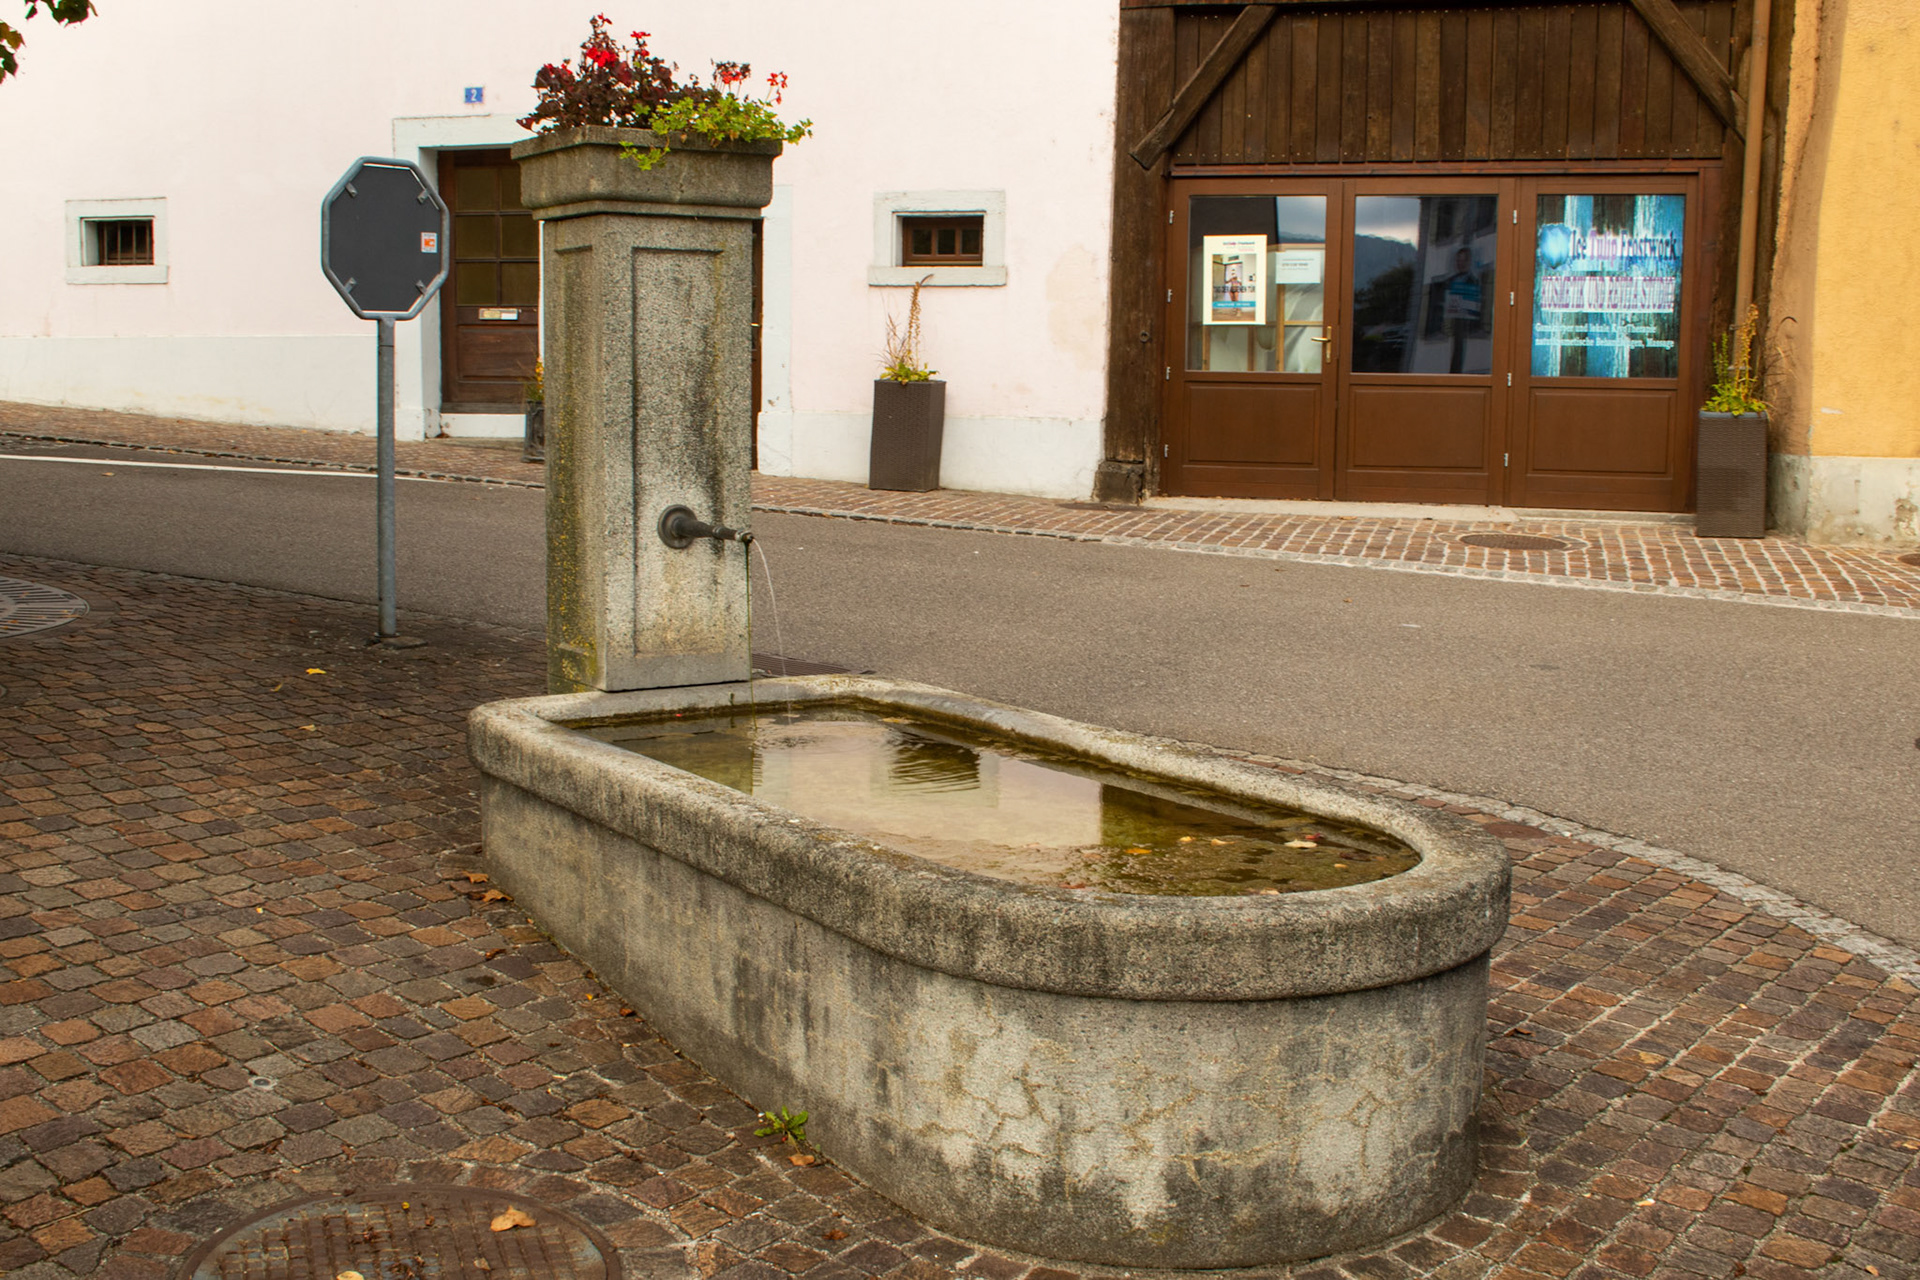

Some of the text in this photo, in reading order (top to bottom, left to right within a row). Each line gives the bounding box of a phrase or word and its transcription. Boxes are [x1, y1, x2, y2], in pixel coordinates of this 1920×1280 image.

[471, 89, 478, 101] 2
[1572, 229, 1677, 267] Ice Tulip Frostwork
